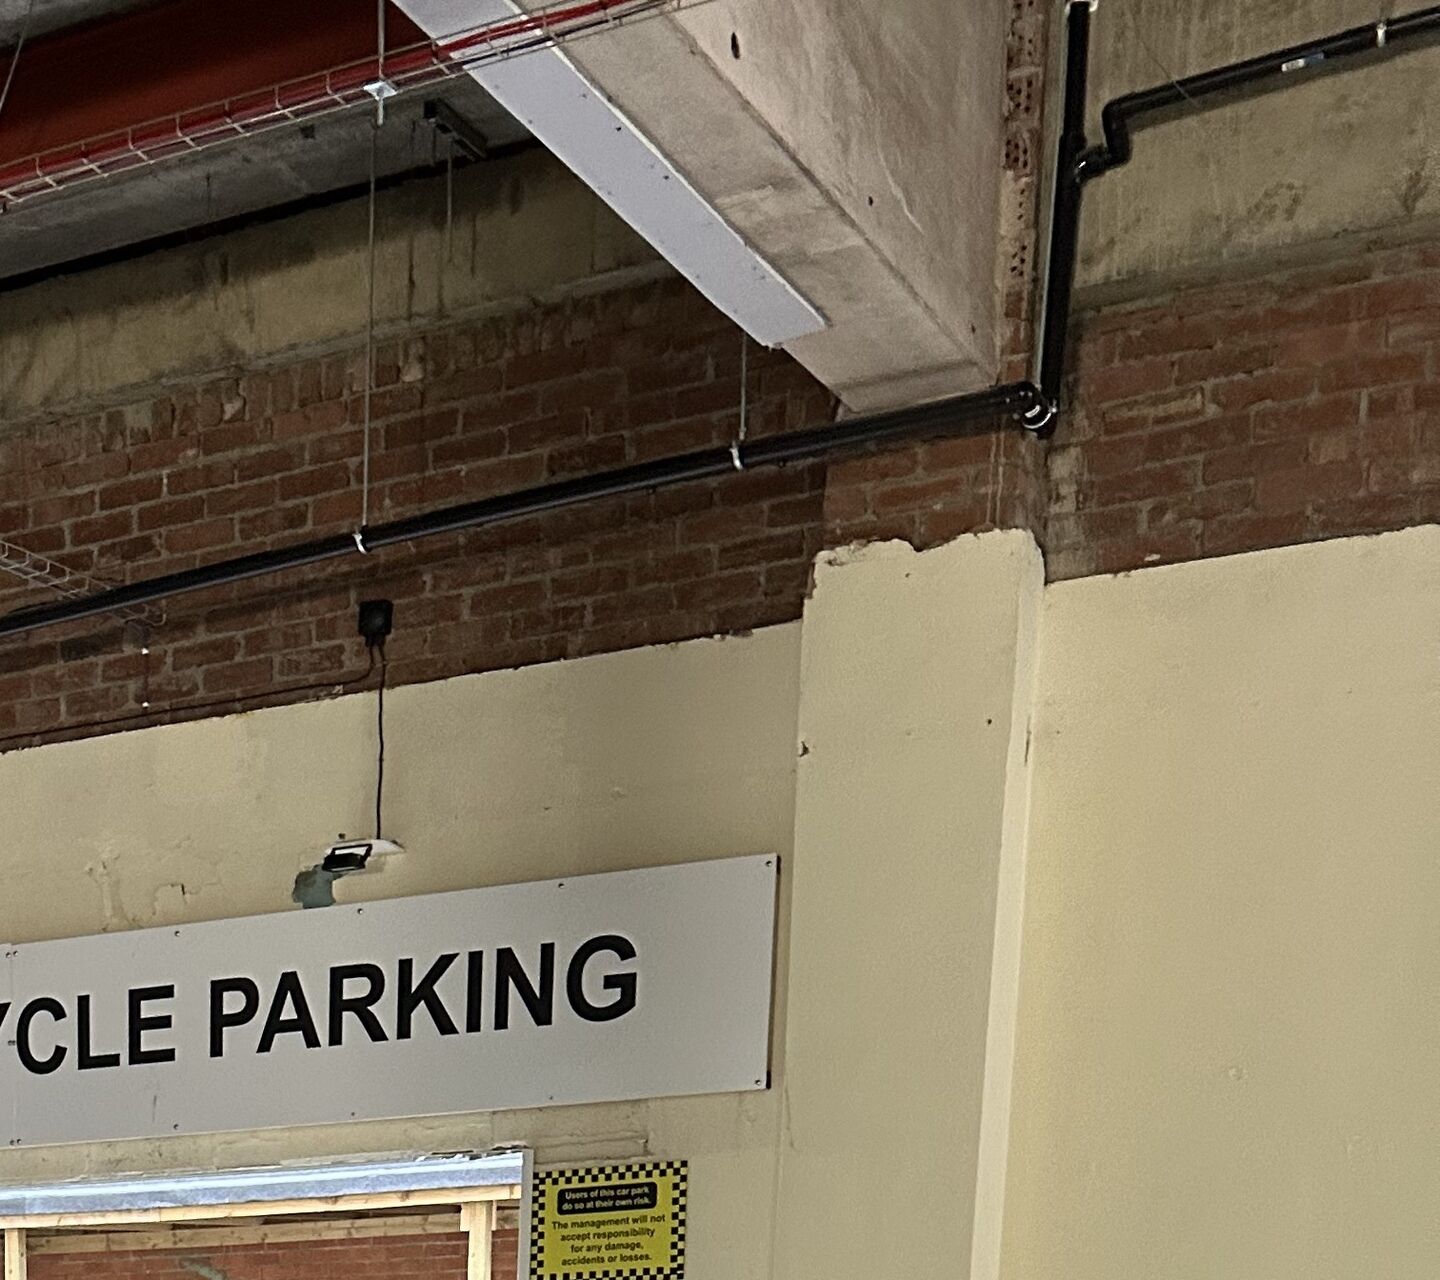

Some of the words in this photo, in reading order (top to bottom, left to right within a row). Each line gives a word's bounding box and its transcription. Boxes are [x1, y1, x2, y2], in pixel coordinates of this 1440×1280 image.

[209, 934, 638, 1058] PARKING
[565, 1191, 588, 1199] Users
[590, 1189, 599, 1197] of
[600, 1188, 615, 1196] this
[617, 1188, 629, 1196] car
[631, 1186, 649, 1194] park
[562, 1202, 573, 1210] do
[595, 1200, 613, 1208] their
[615, 1198, 632, 1207] own
[634, 1197, 651, 1205] risk.
[552, 1221, 569, 1230] The
[570, 1217, 629, 1228] management
[631, 1214, 648, 1224] will
[650, 1214, 666, 1223] not
[560, 1231, 591, 1241] accept
[593, 1228, 655, 1239] responsibility
[571, 1244, 583, 1253] for
[585, 1244, 603, 1253] any
[604, 1241, 644, 1251] damage,
[561, 1255, 605, 1266] accidents
[620, 1253, 653, 1262] losses.
